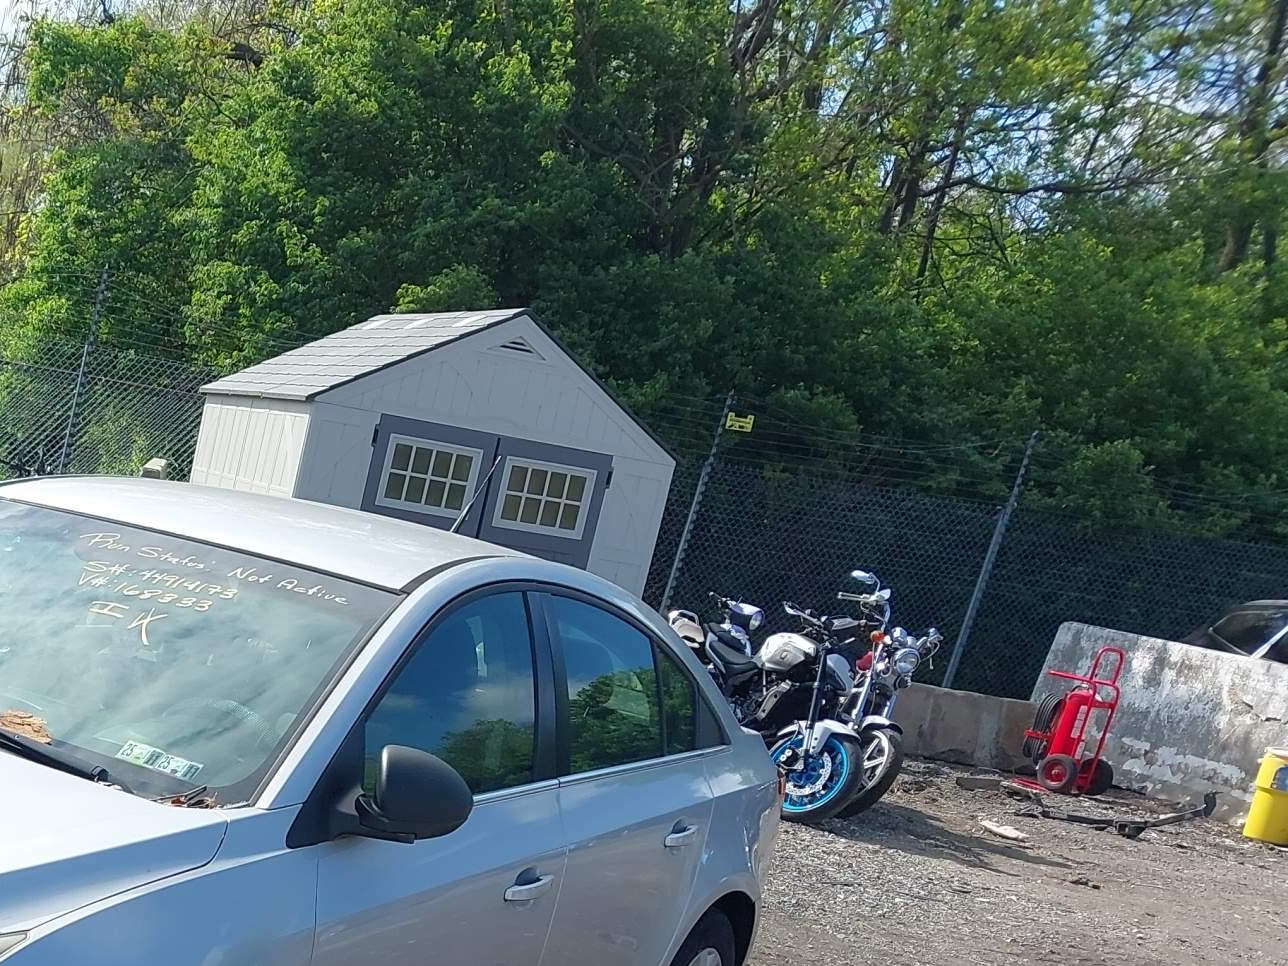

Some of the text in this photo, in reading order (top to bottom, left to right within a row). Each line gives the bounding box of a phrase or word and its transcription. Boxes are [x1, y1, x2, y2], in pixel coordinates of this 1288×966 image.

[80, 533, 130, 552] Run
[227, 567, 273, 583] Not
[276, 579, 350, 605] Active
[121, 743, 138, 757] 25
[157, 755, 174, 770] 25
